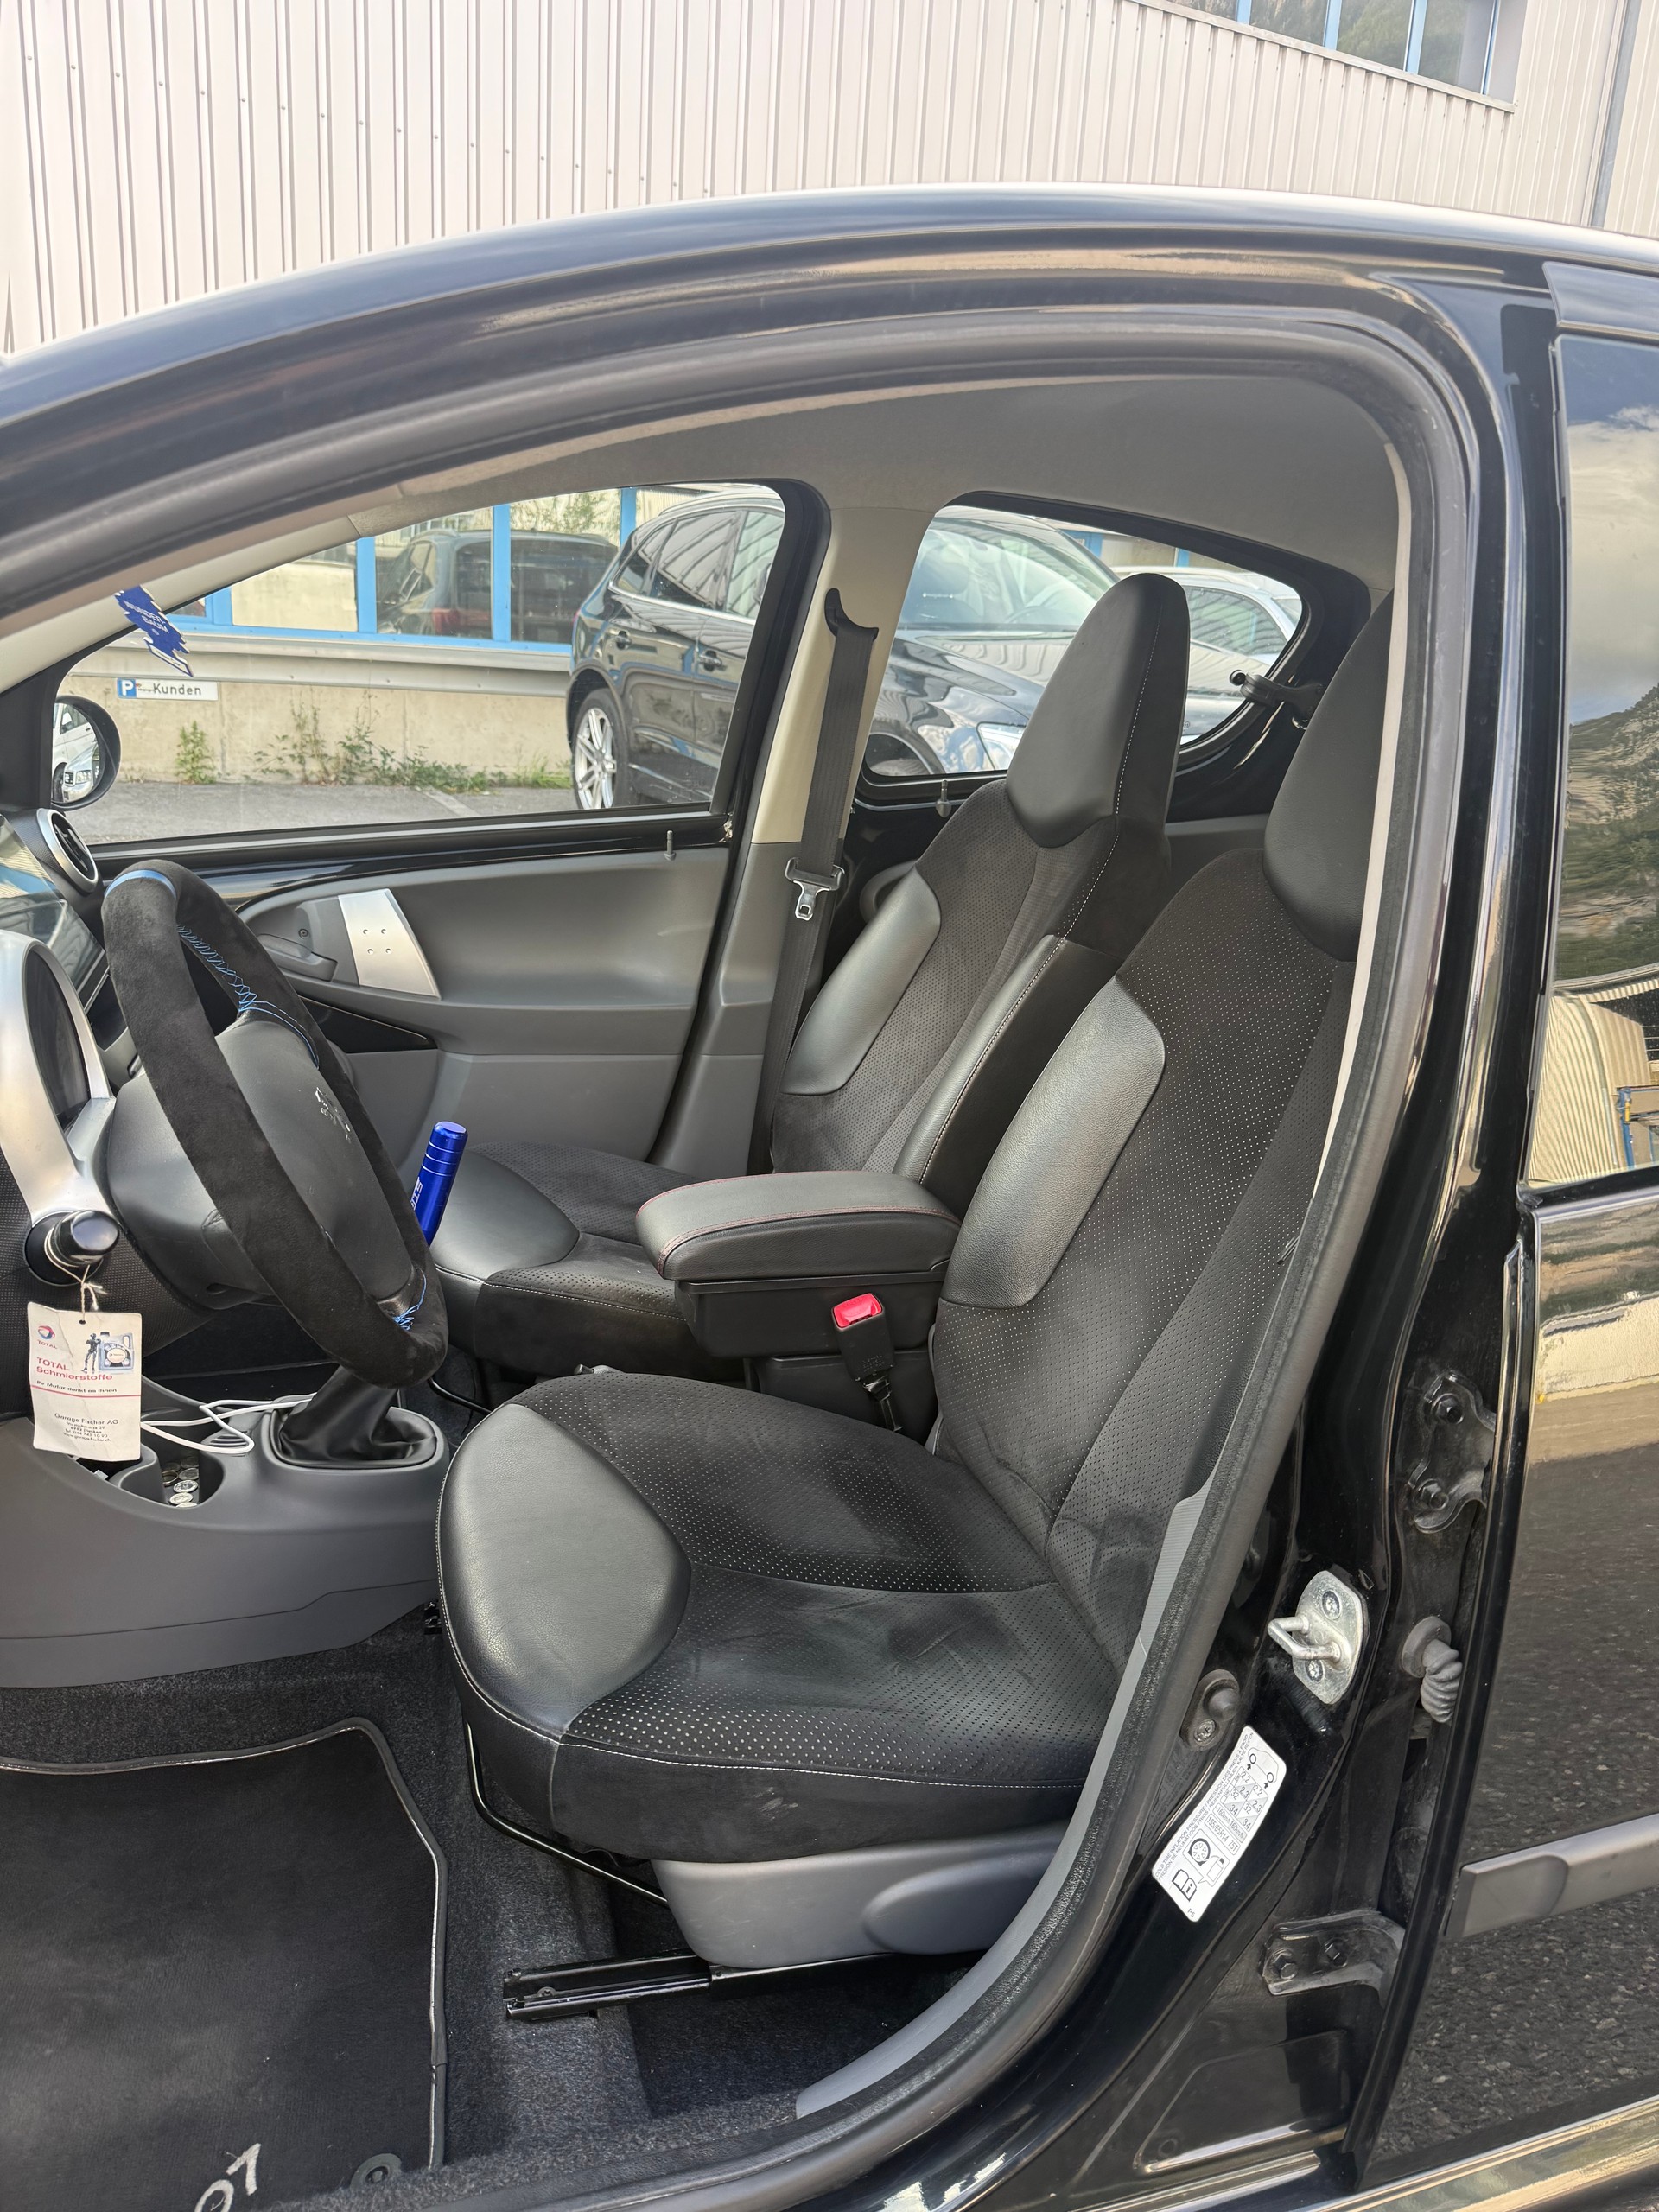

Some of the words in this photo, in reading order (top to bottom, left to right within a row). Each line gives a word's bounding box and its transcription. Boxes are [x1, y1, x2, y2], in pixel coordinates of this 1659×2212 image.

[142, 615, 169, 634] BAUM
[122, 680, 133, 696] P
[153, 683, 201, 695] Kunden
[38, 1339, 57, 1349] TOTAL
[36, 1366, 112, 1380] Schmierstoffe
[37, 1357, 69, 1370] TOTAL
[54, 1413, 79, 1422] Garage
[1241, 1771, 1250, 1783] 2.2
[1254, 1785, 1262, 1796] 2.2
[1230, 1789, 1239, 1800] 32
[1244, 1803, 1251, 1814] 32
[1240, 1787, 1249, 1799] 2.3
[1253, 1800, 1262, 1813] 2.3
[1155, 1863, 1164, 1877] COLD
[1170, 1829, 1187, 1853] INFLATION
[1186, 1806, 1205, 1830] PRESSURE
[1206, 1780, 1224, 1803] PRESSION
[1229, 1753, 1239, 1770] PNEUS
[1230, 1804, 1238, 1815] 34
[1243, 1818, 1251, 1830] 34
[1207, 1817, 1229, 1842] 155/65R14
[1228, 1840, 1238, 1851] 75T
